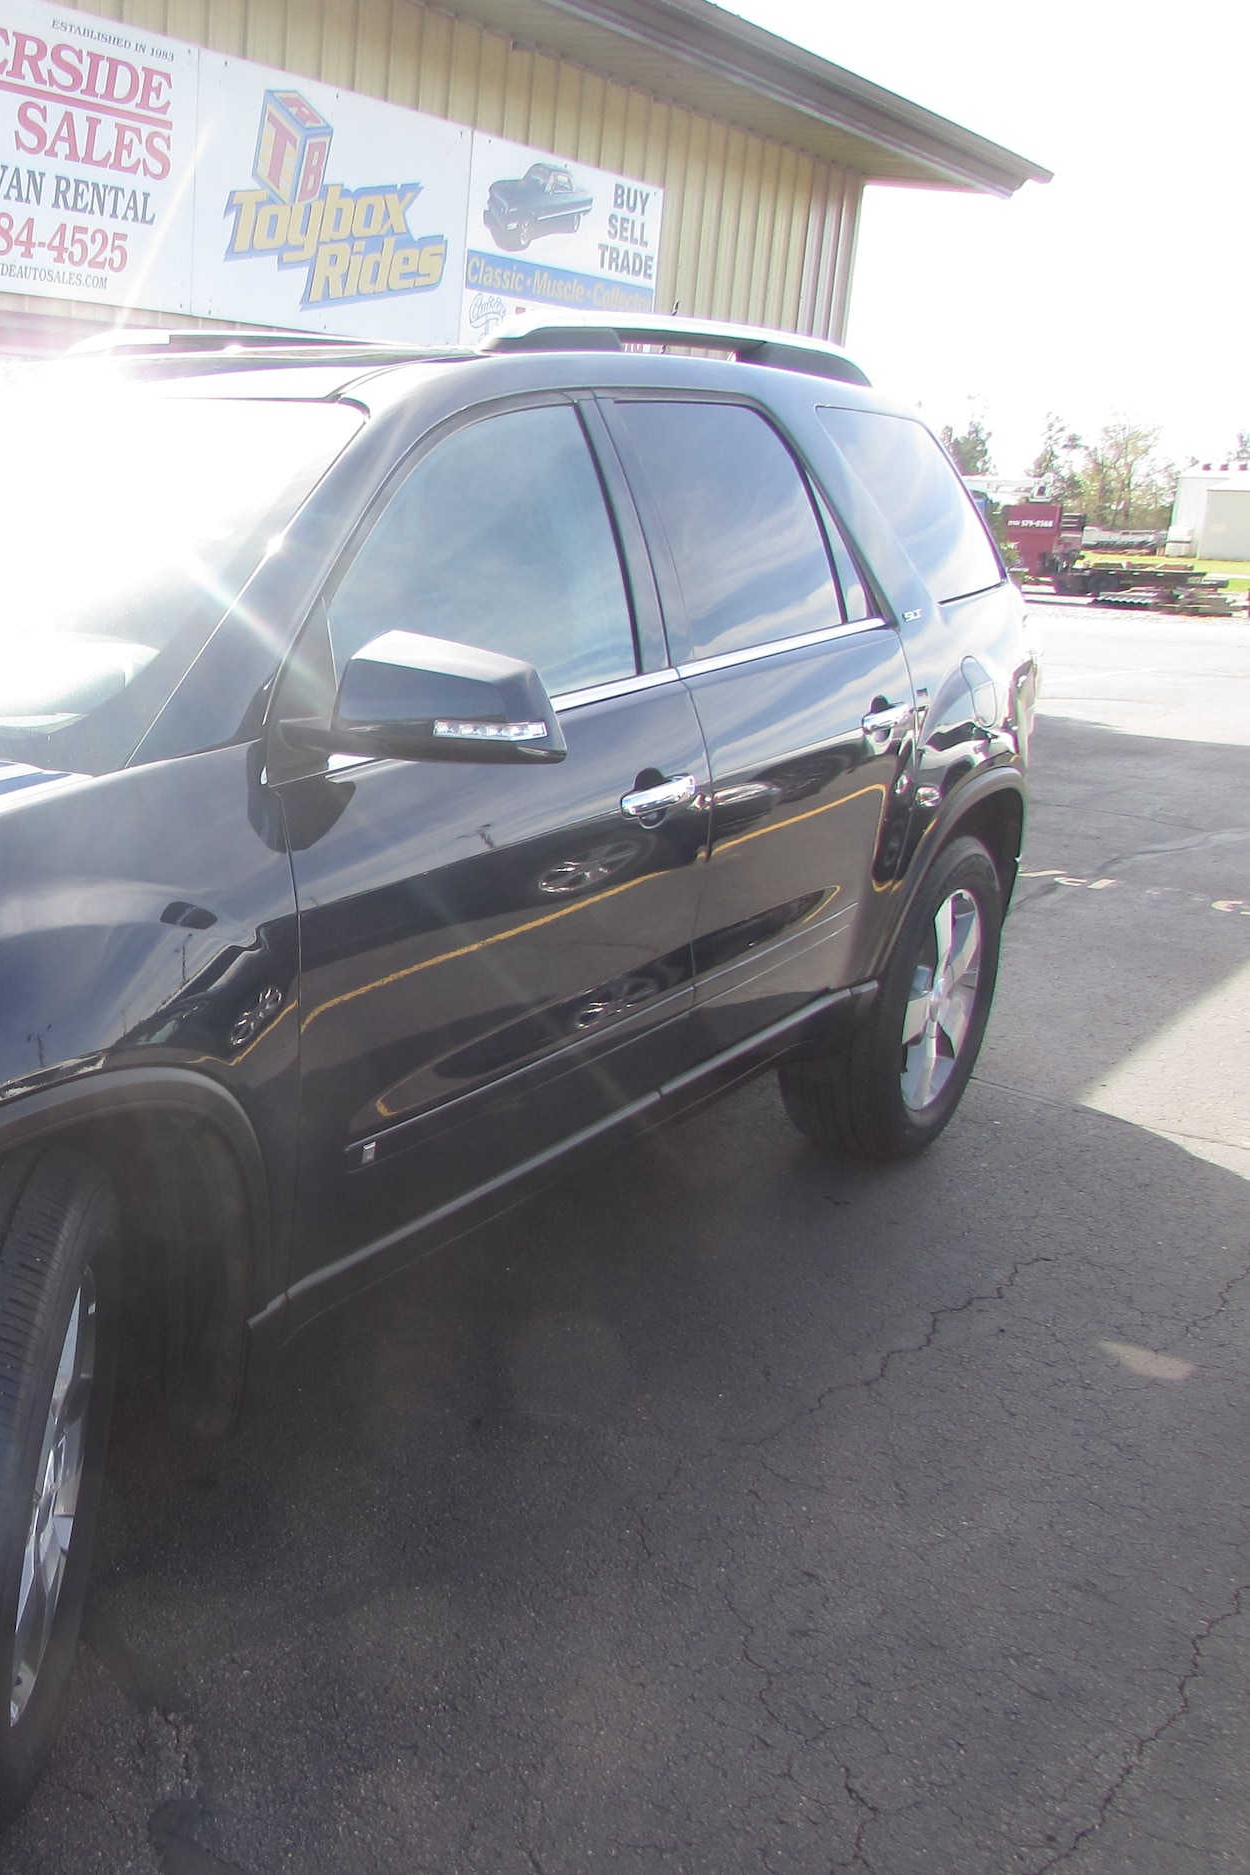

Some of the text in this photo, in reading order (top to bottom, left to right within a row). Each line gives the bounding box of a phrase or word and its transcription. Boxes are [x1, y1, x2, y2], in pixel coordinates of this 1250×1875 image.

[50, 19, 175, 62] ESTABLISHED IN 1983
[14, 100, 171, 181] SALES
[52, 175, 156, 226] RENTAL
[613, 183, 651, 217] BUY
[229, 186, 417, 264] Toybox
[607, 213, 649, 248] SELL
[309, 237, 446, 304] Rides
[467, 256, 524, 292] Classic
[532, 271, 584, 303] Muscle
[598, 243, 654, 280] TRADE
